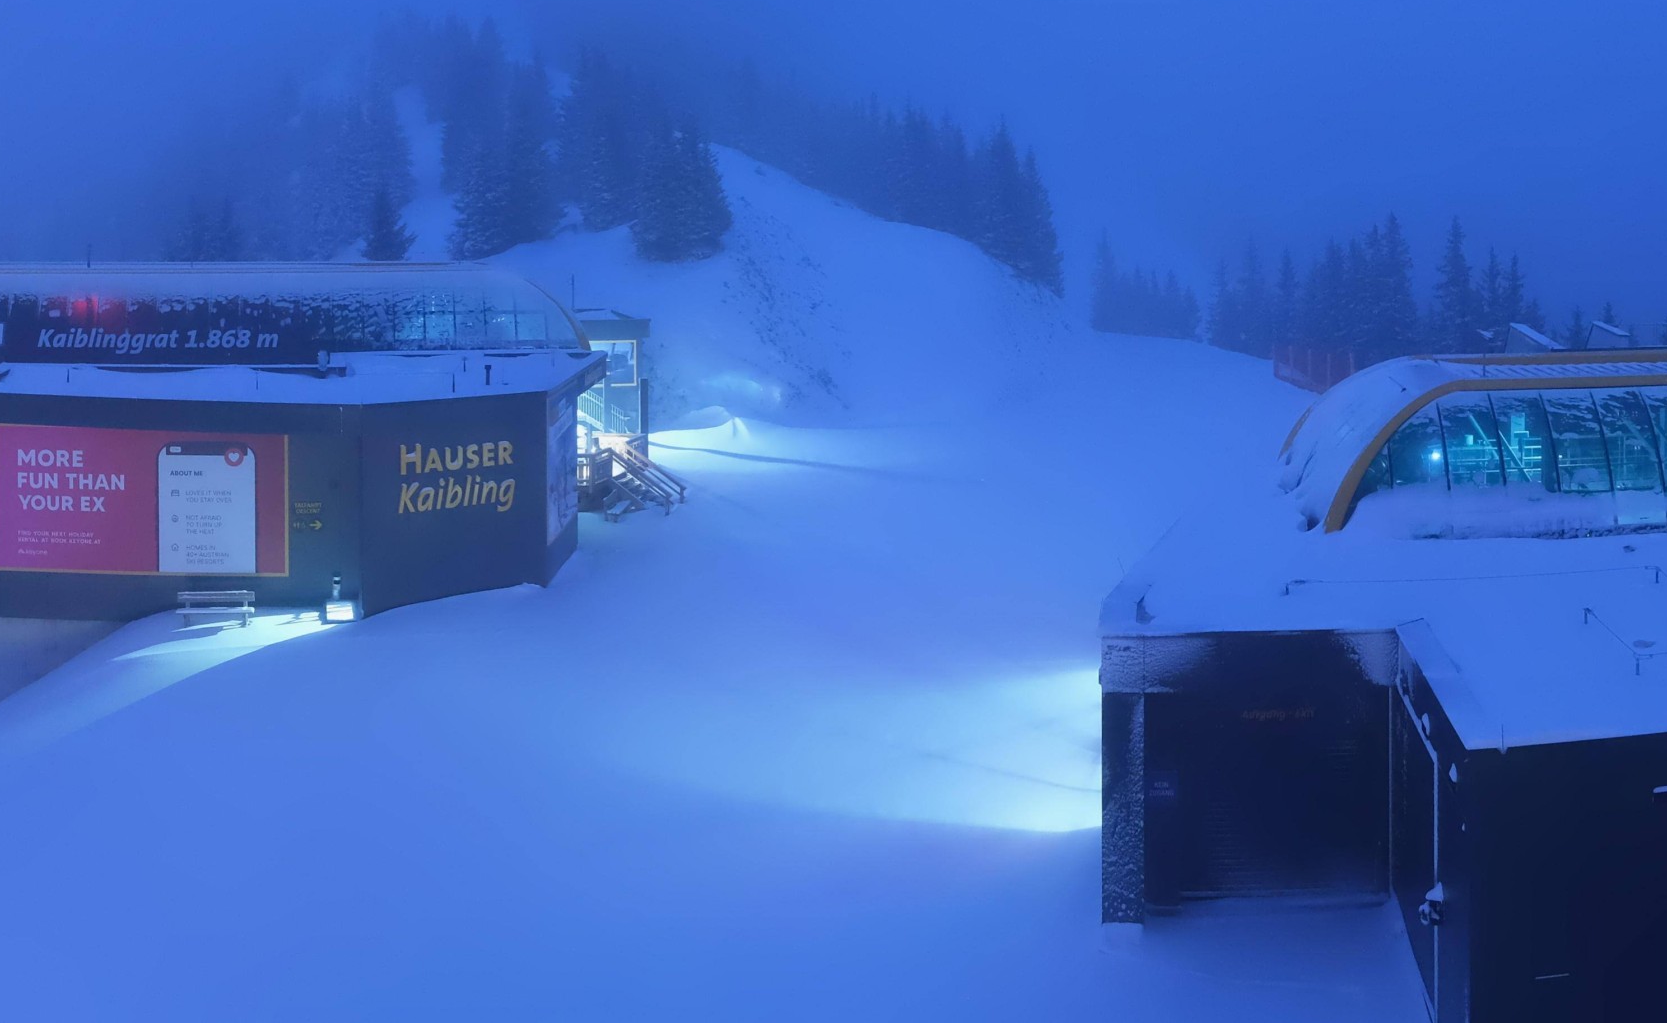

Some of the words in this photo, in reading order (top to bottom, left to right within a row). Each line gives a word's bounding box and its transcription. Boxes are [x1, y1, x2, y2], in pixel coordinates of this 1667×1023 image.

[37, 327, 179, 354] Kaiblinggrat
[185, 328, 251, 349] 1.868
[256, 332, 279, 348] m
[17, 448, 84, 468] MORE
[399, 440, 514, 476] HAUSER
[17, 472, 59, 490] FUN
[65, 472, 126, 491] THAN
[169, 469, 193, 477] ABOUT
[193, 469, 203, 477] ME
[18, 493, 74, 512] YOUR
[80, 495, 107, 513] EX
[398, 474, 516, 514] Kaibling
[68, 531, 95, 539] HOLIDAY
